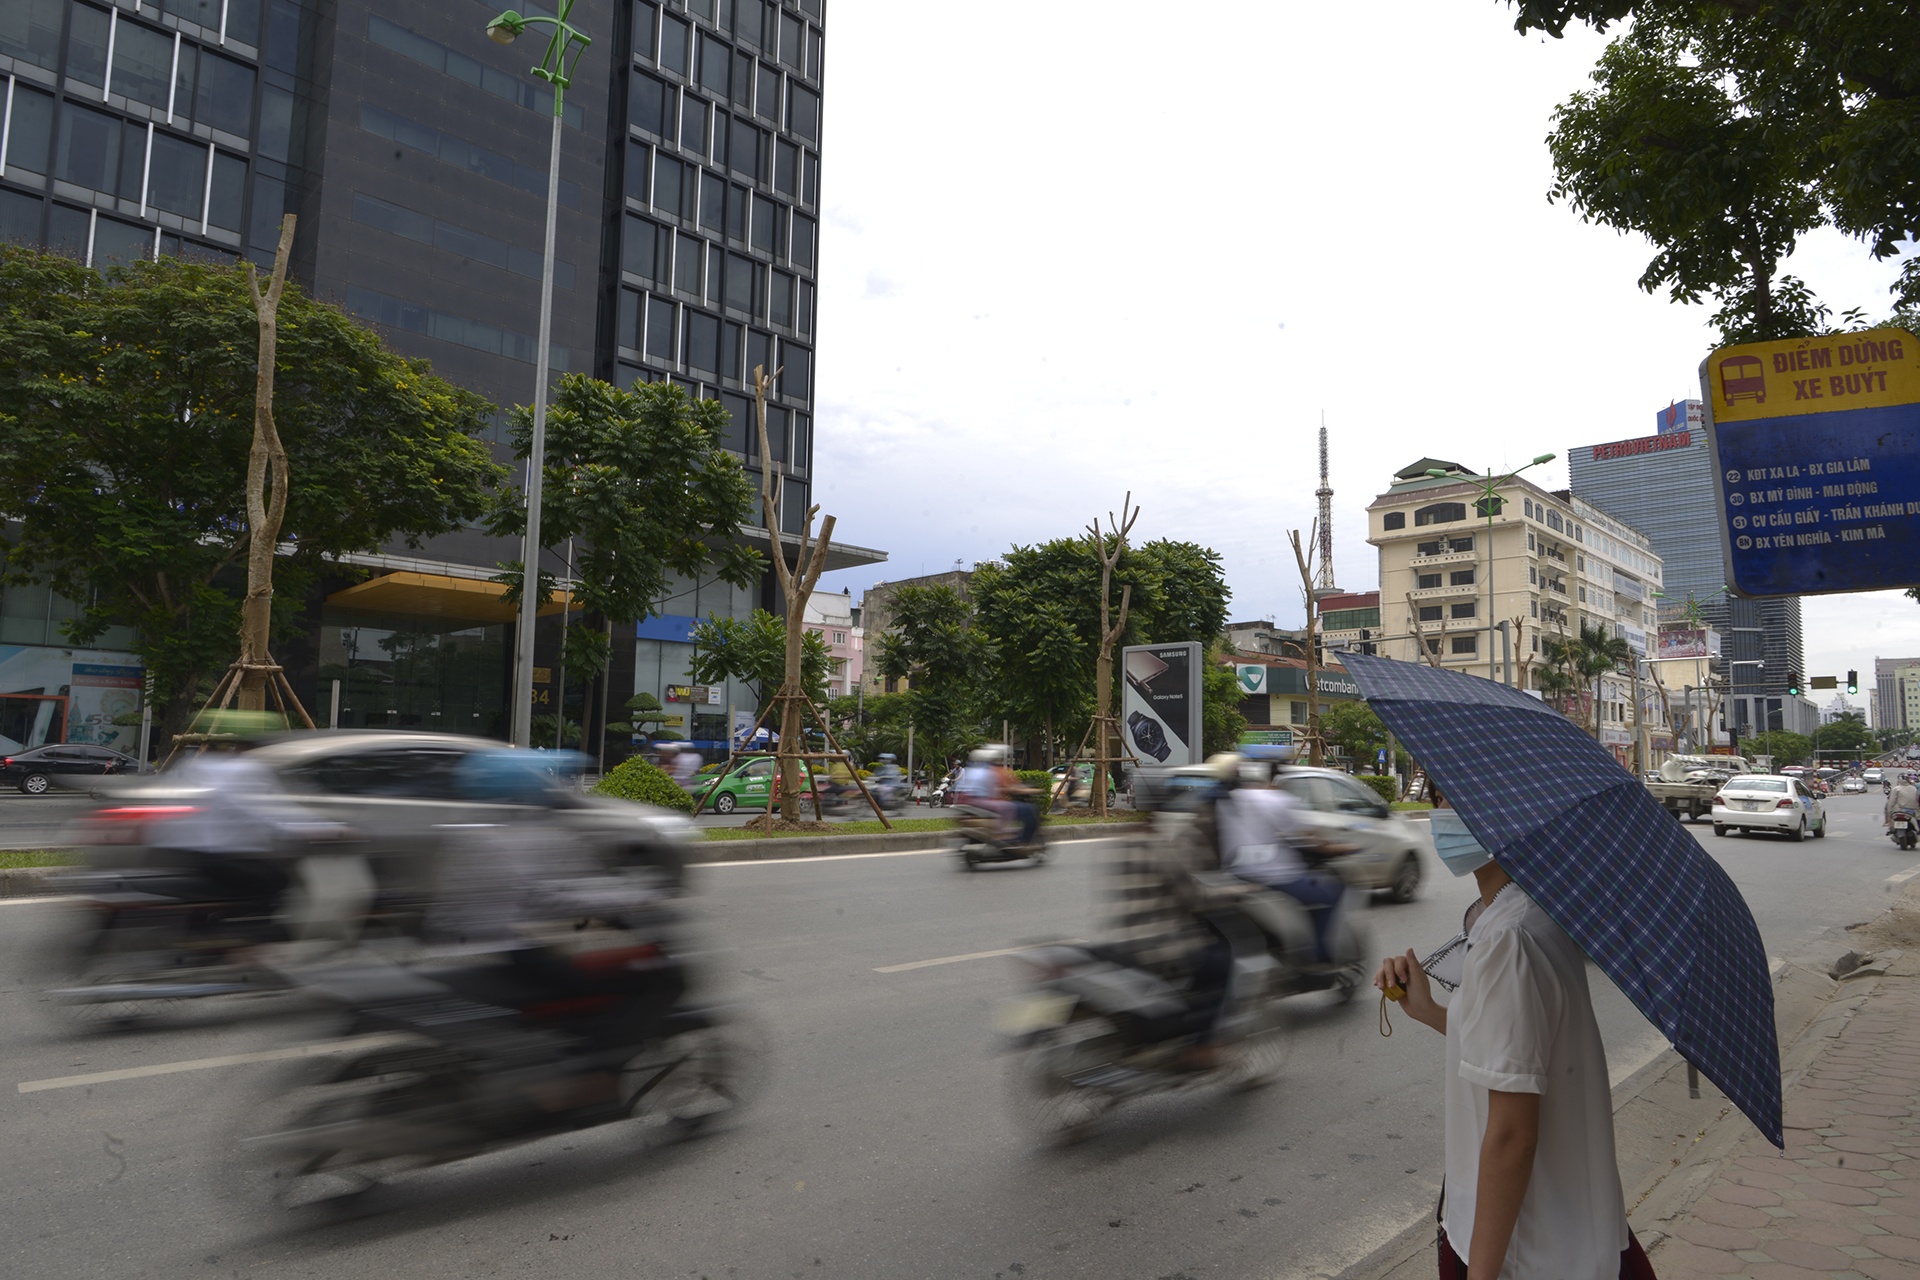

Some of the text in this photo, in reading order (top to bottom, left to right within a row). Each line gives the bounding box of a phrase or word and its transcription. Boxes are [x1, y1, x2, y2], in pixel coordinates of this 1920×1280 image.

[1773, 337, 1904, 373] ĐIỂM DỪNG
[1793, 366, 1887, 401] XE BUÝT
[1593, 431, 1691, 461] PETROVIETNAM
[1769, 467, 1784, 479] XA
[1786, 465, 1799, 478] LA
[1809, 463, 1824, 476] BX
[1826, 461, 1845, 474] GIA
[1847, 456, 1870, 472] LÂM
[1750, 491, 1765, 504] BX
[1823, 484, 1845, 497] MAI
[1752, 515, 1766, 528] CV
[1794, 506, 1820, 524] GIẤY
[1864, 501, 1904, 518] KHÁNH
[1756, 537, 1771, 549] BX
[1772, 533, 1794, 547] YÊN
[1841, 528, 1864, 541] KIM
[1866, 524, 1886, 539] MÃ
